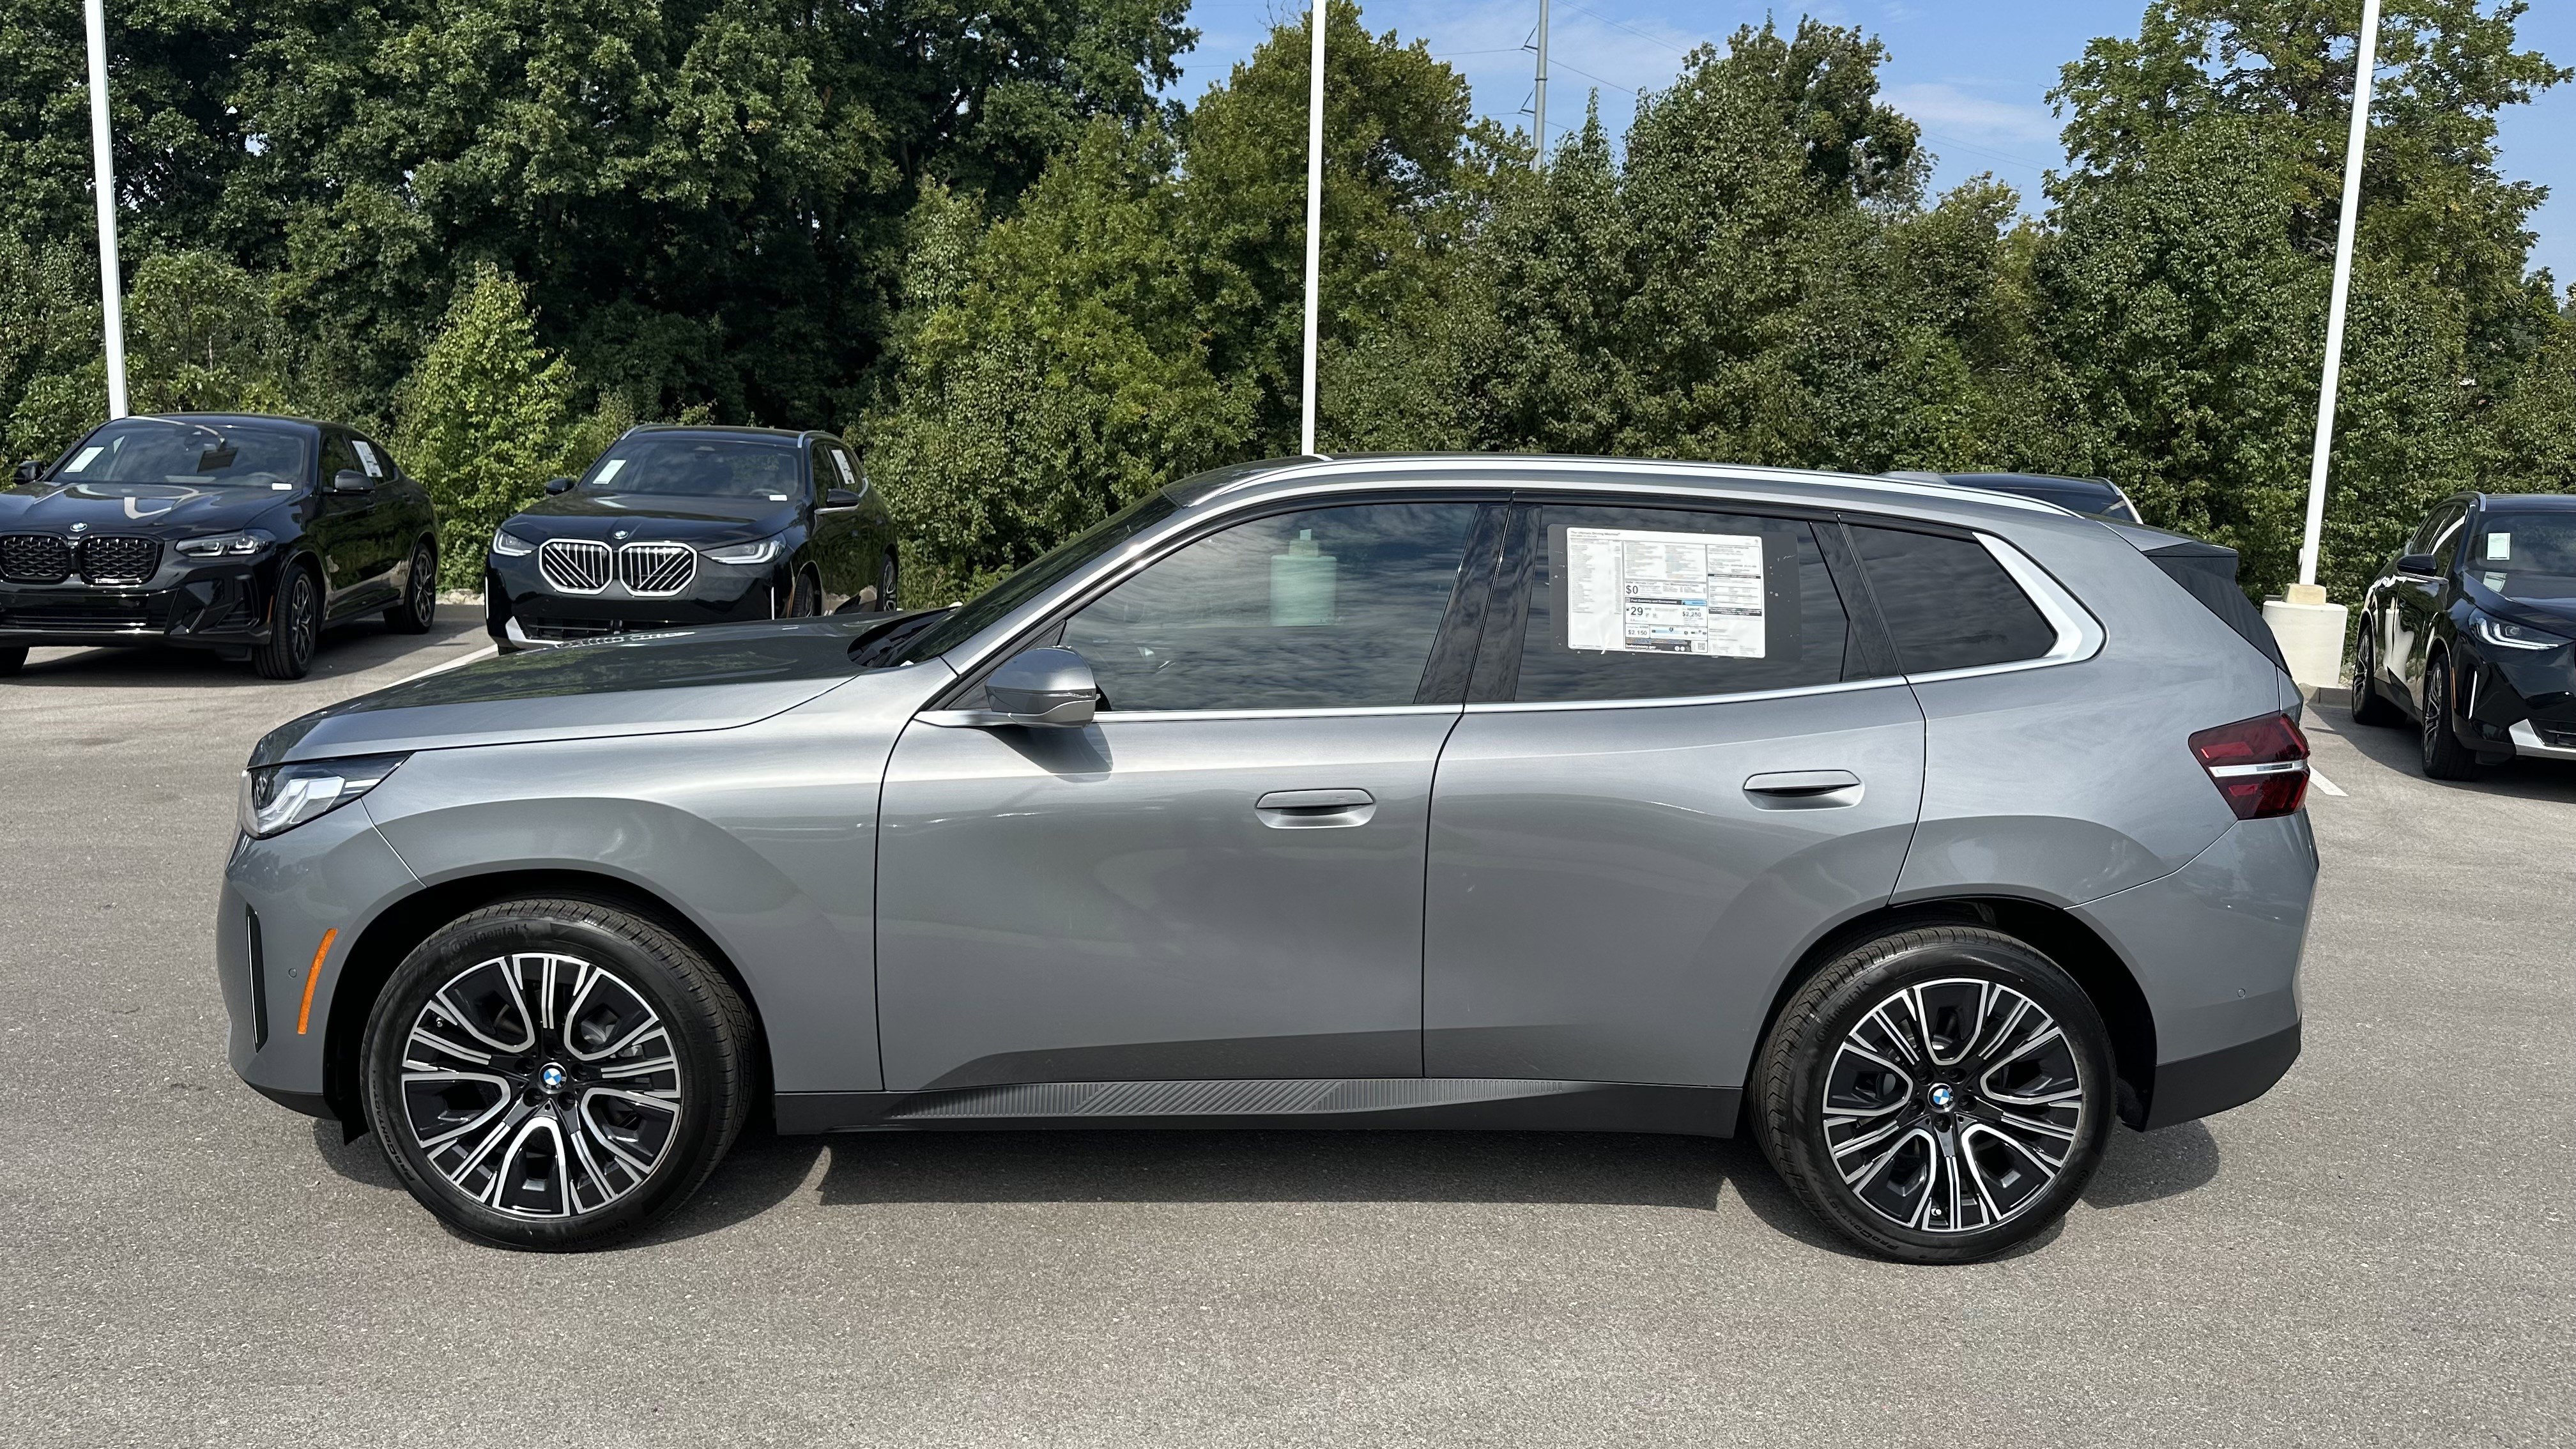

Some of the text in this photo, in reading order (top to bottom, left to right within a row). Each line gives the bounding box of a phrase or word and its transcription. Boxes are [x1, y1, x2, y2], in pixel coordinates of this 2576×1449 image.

[1625, 585, 1638, 595] $0
[1630, 606, 1643, 616] 29
[448, 923, 519, 954] Continental
